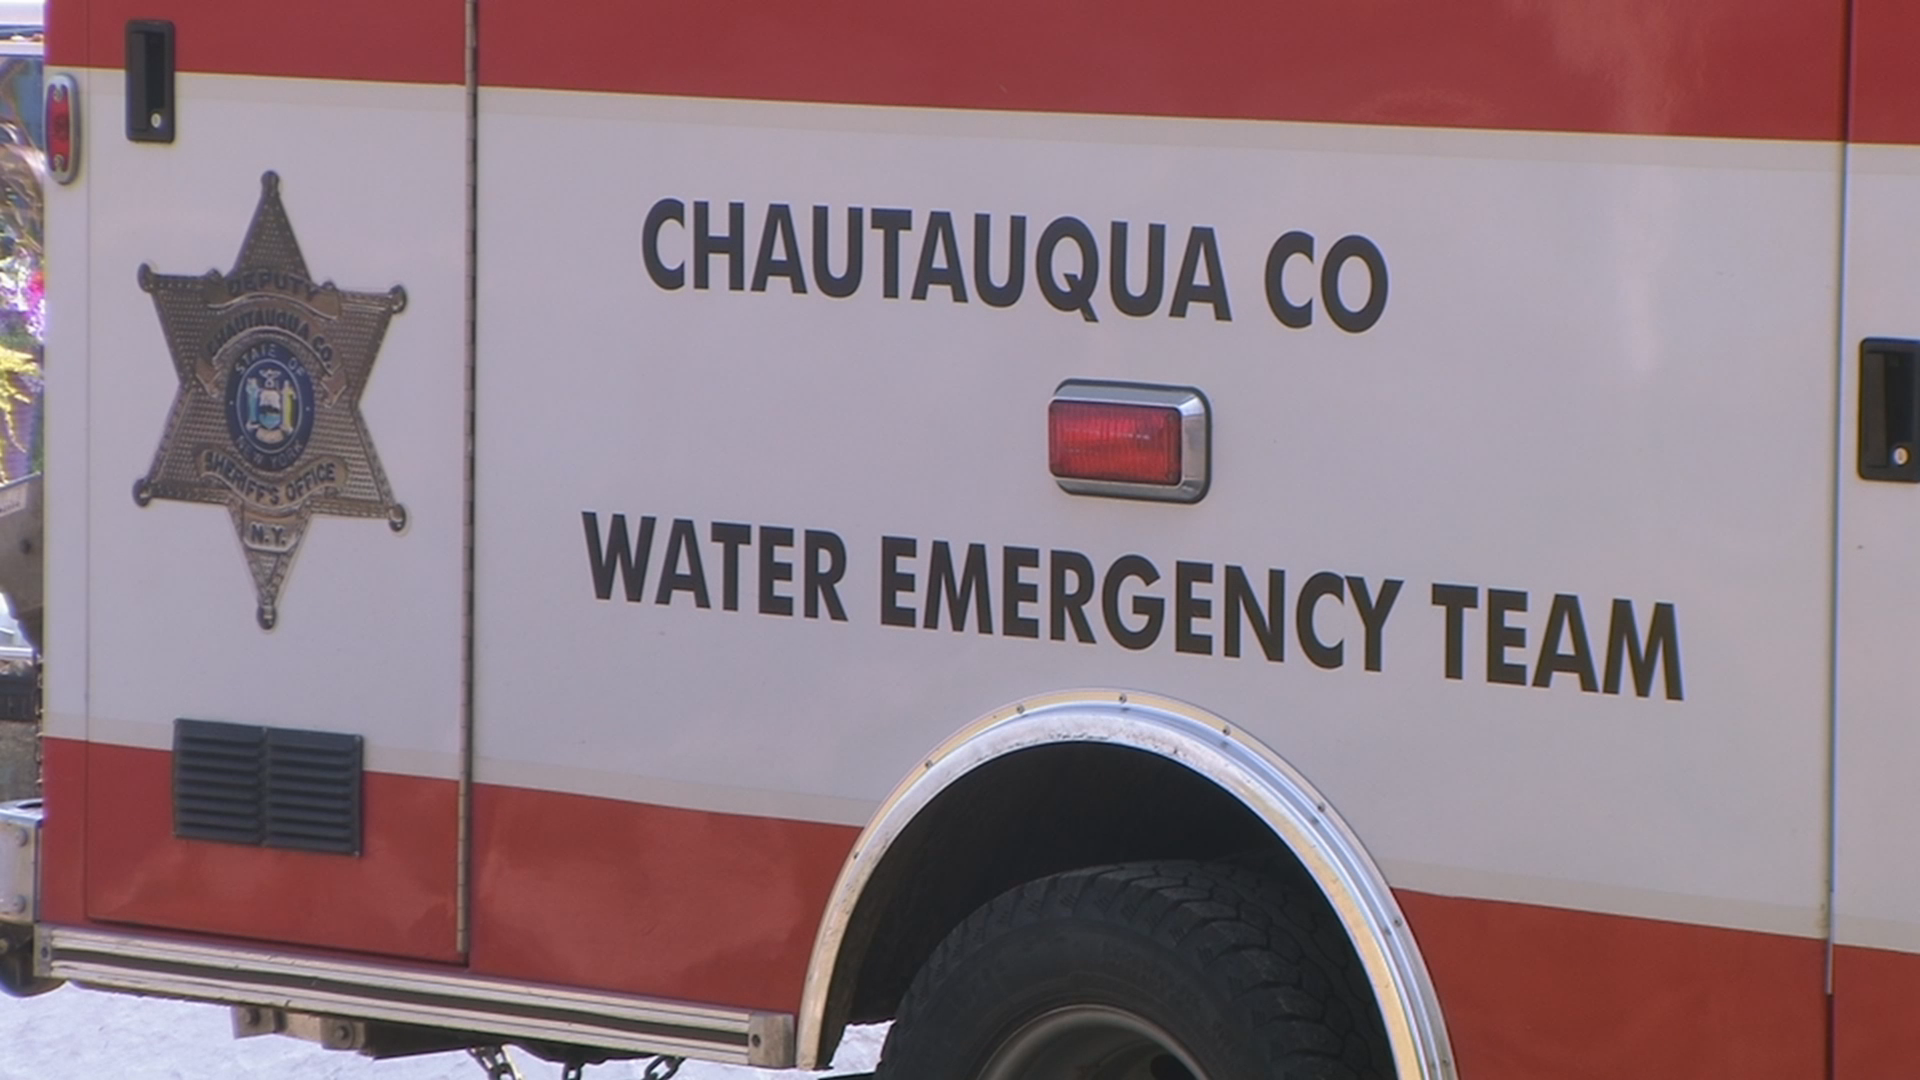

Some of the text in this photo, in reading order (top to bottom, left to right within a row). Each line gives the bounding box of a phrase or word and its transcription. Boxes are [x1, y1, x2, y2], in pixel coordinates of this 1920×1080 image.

[227, 269, 320, 298] DEPUTY
[642, 198, 1389, 333] CHAUTAUQUA CO
[208, 308, 310, 353] CHAUTAUQUA
[235, 343, 306, 376] STATE OF
[237, 435, 304, 468] NEW YORK
[206, 451, 336, 505] SHERIFF'S OFFICE
[251, 523, 286, 546] N.Y.
[582, 511, 1684, 701] WATER EMERGENCY TEAM
